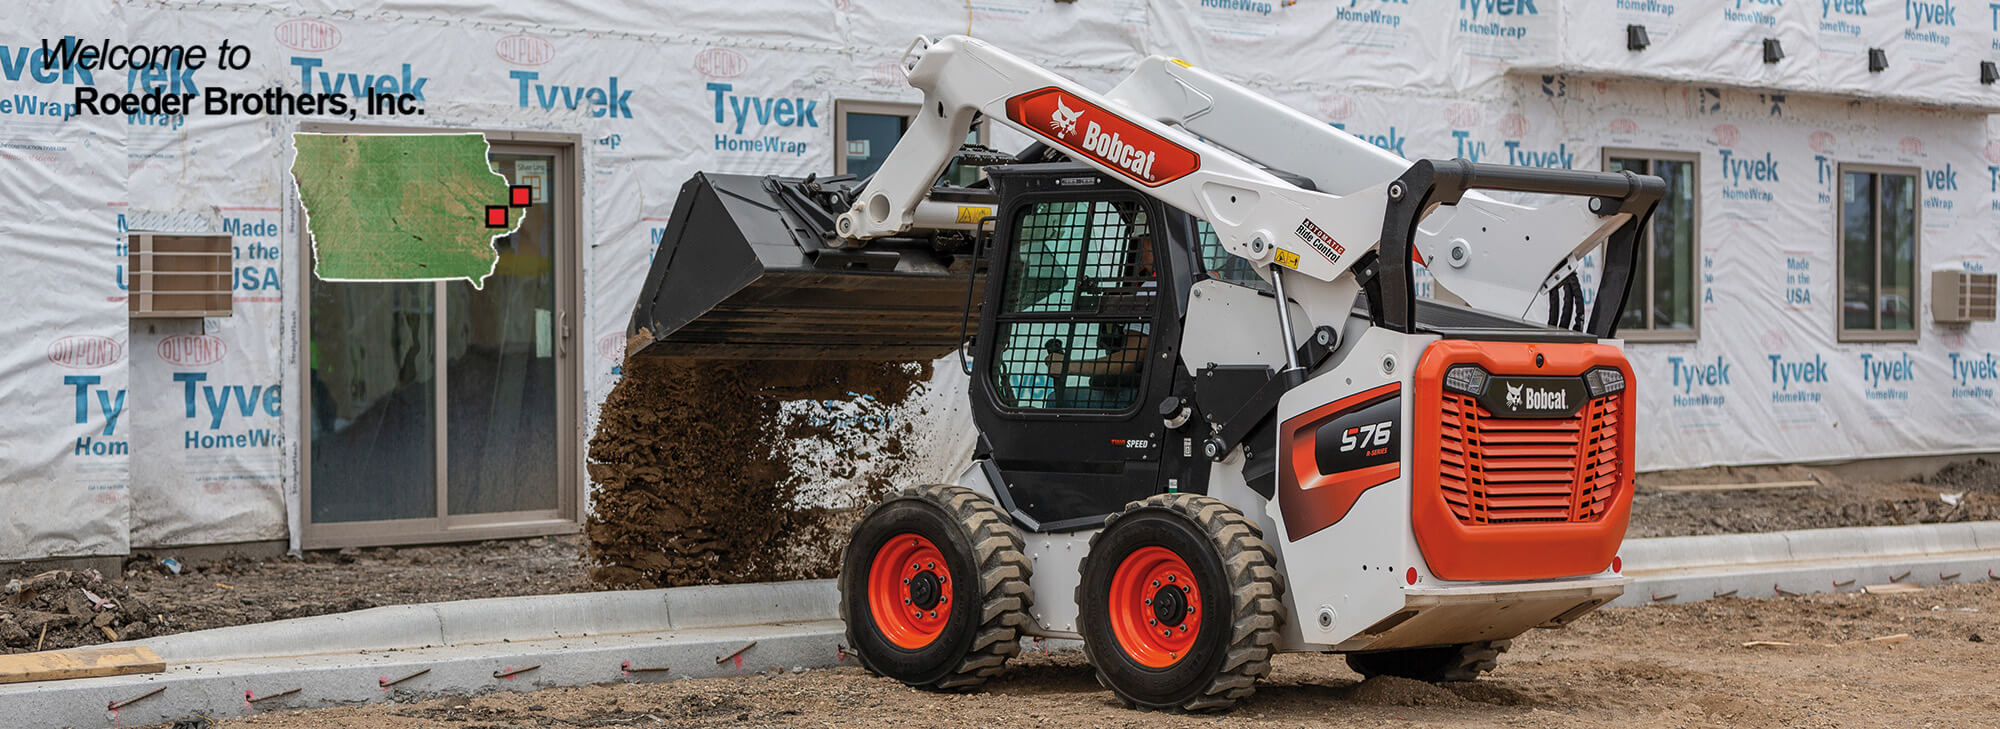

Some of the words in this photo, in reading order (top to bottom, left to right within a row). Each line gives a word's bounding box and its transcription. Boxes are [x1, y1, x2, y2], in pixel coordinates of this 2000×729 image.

[1336, 7, 1400, 28] HomeWrap
[1904, 28, 1950, 47] HomeWrap
[509, 69, 633, 119] Tyvek
[705, 82, 819, 135] Tyvek
[714, 133, 807, 157] HomeWrap
[1082, 120, 1156, 181] Bobcat
[1719, 149, 1779, 188] Tyvek
[223, 217, 278, 238] Made
[1303, 219, 1345, 255] AUTOMATIC
[248, 241, 280, 261] the
[1295, 224, 1314, 242] Ride
[1312, 238, 1341, 263] Control
[1787, 257, 1809, 271] Made
[1786, 287, 1812, 304] USA
[1668, 354, 1731, 394] Tyvek
[1767, 353, 1829, 391] Tyvek
[1860, 352, 1914, 388] Tyvek
[1948, 352, 1998, 387] Tyvek
[1525, 387, 1567, 410] Bobcat
[1673, 394, 1725, 407] HomeWrap
[1772, 390, 1822, 403] HomeWrap
[1865, 388, 1909, 400] HomeWrap
[1952, 387, 1994, 399] HomeWrap
[1126, 439, 1149, 449] SPEED
[1340, 420, 1393, 452] S76
